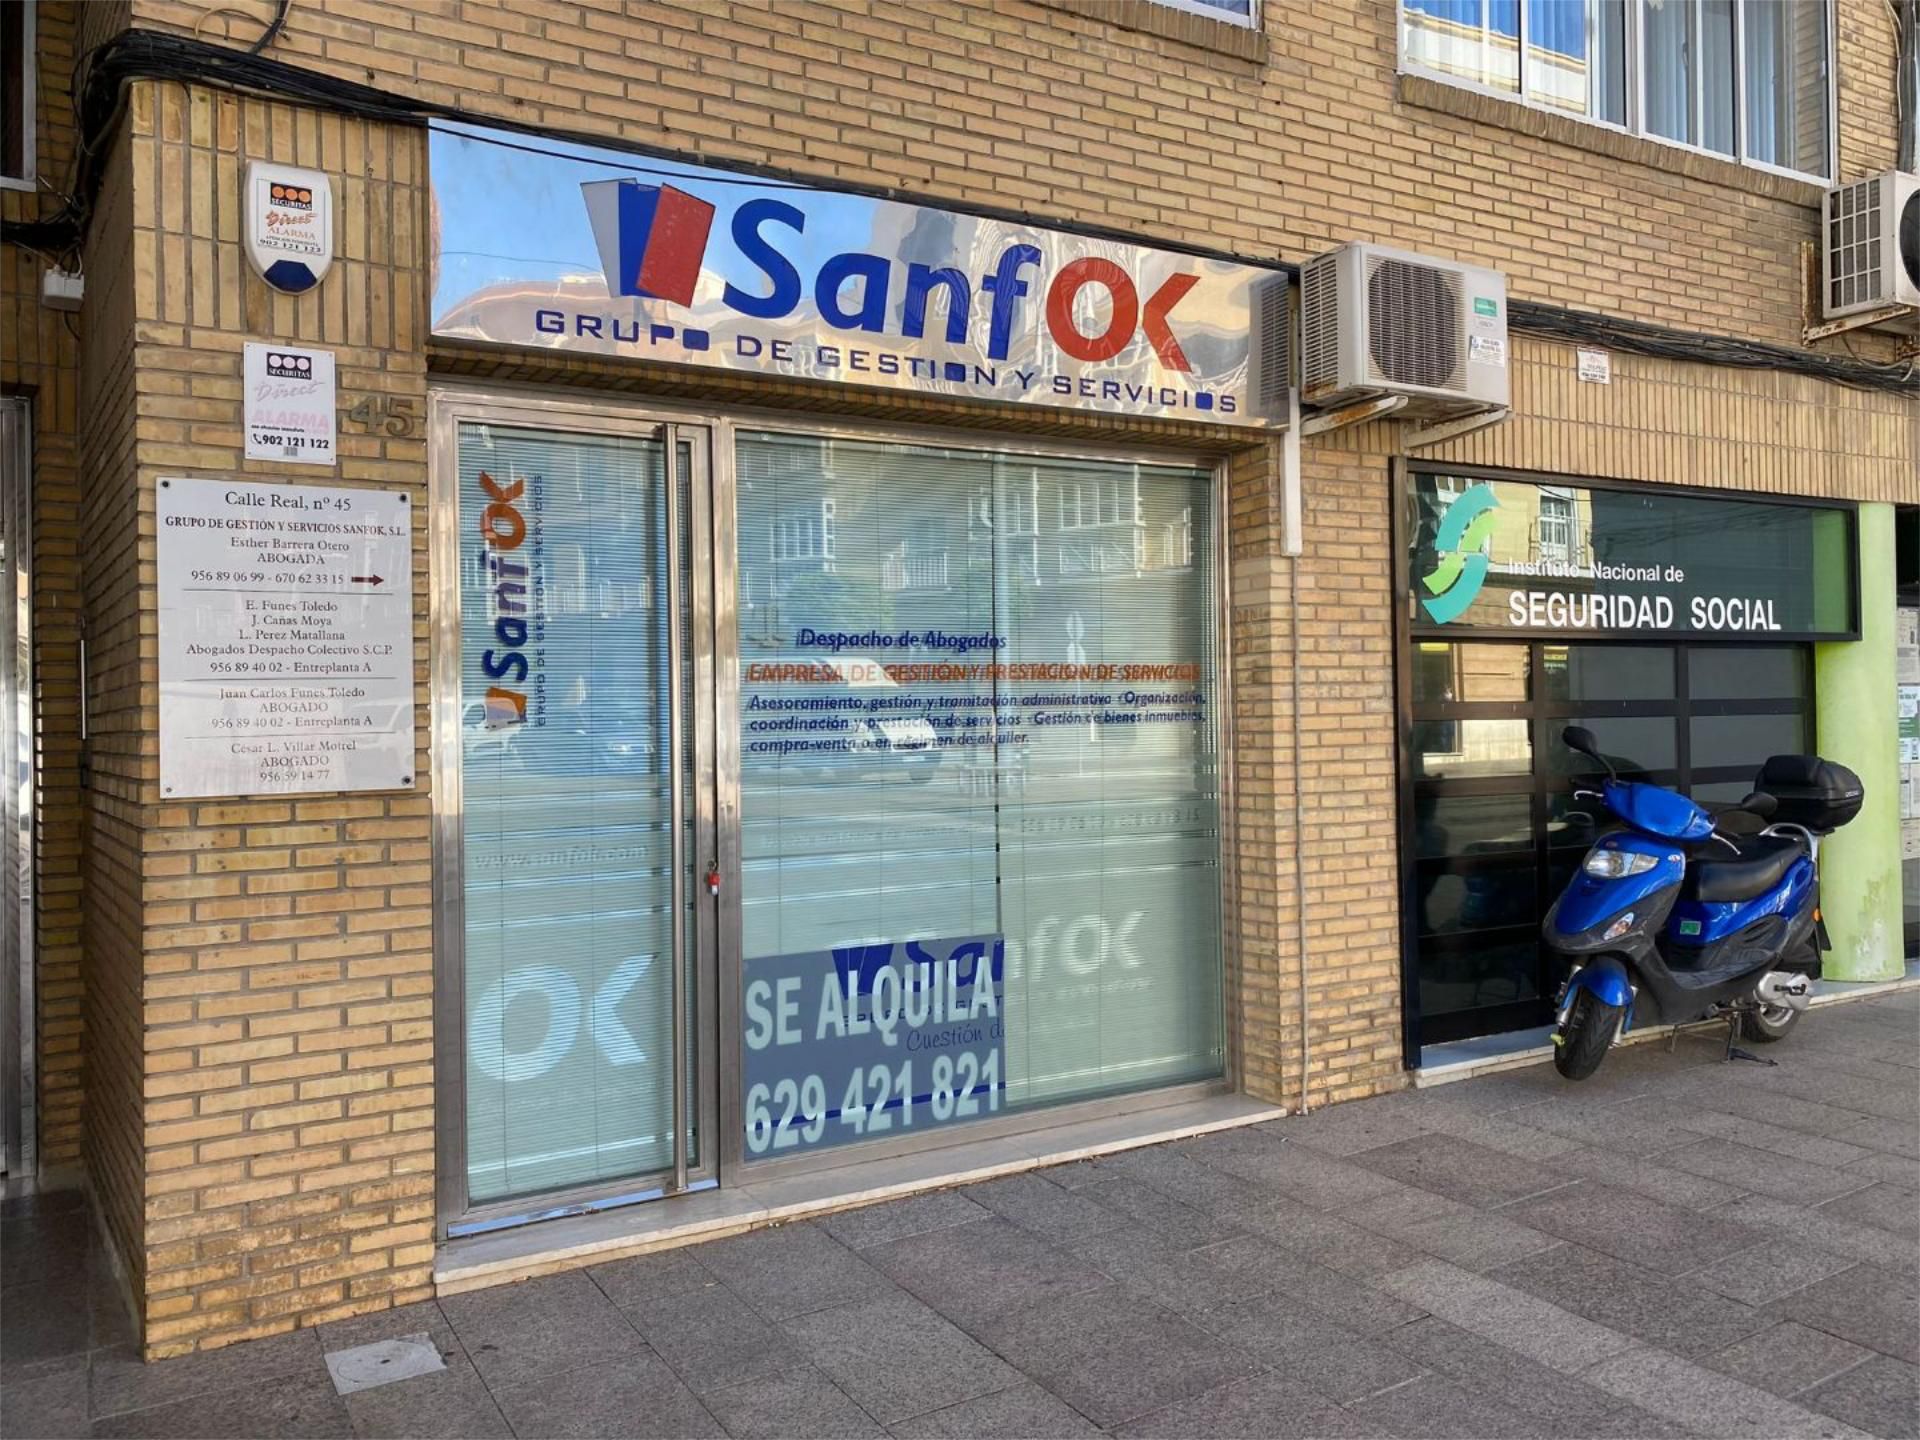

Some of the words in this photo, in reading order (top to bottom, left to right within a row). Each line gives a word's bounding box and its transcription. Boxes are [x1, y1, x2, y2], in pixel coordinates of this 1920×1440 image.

[267, 226, 316, 241] ALARMA
[722, 197, 1201, 373] SanfOK
[536, 309, 710, 351] GRUPO
[737, 335, 793, 361] DE
[817, 345, 996, 387] GESTION
[1016, 371, 1035, 390] Y
[1053, 375, 1237, 413] SERVICIOS
[268, 368, 310, 379] SECURITAS
[254, 380, 327, 402] Direct
[253, 409, 330, 435] ALARMA
[350, 393, 415, 438] 45
[262, 434, 283, 446] 902
[287, 436, 305, 448] 121
[310, 438, 330, 449] 122
[225, 490, 263, 507] Calle
[270, 493, 309, 511] Real,
[334, 498, 352, 512] 45
[165, 515, 206, 528] GRUPO
[208, 517, 224, 529] DE
[278, 520, 285, 532] Y
[287, 522, 341, 534] SERVICIOS
[389, 526, 406, 537] S.L.
[231, 536, 269, 550] Esther
[273, 537, 314, 550] Barrera
[318, 539, 350, 552] Otero
[257, 552, 325, 565] ABOGADA
[191, 570, 213, 582] 956
[216, 571, 231, 582] 89
[233, 571, 248, 583] 06
[250, 572, 265, 583] 99
[275, 573, 296, 584] 670
[298, 574, 312, 584] 62
[315, 574, 328, 585] 33
[331, 574, 344, 585] 15
[1508, 557, 1580, 579] Instituto
[1591, 561, 1660, 583] Nacional
[1664, 564, 1685, 584] de
[246, 600, 258, 611] E.
[262, 600, 297, 611] Funes
[300, 600, 338, 612] Toledo
[1508, 589, 1674, 630] SEGURIDAD
[1690, 596, 1782, 632] SOCIAL
[251, 614, 260, 627] J.
[263, 614, 298, 626] Cañas
[301, 615, 332, 629] Moya
[239, 629, 252, 640] L.
[290, 629, 345, 641] Matallana
[799, 628, 894, 650] Despacho
[900, 630, 919, 646] de
[924, 630, 1007, 652] Abogados
[187, 643, 245, 656] Abogados
[249, 644, 305, 656] Despacho
[307, 644, 360, 655] Colectivo
[362, 644, 393, 656] S.C.P.
[535, 649, 545, 667] DE
[210, 662, 232, 673] 956
[235, 662, 249, 673] 89
[252, 662, 266, 673] 40
[268, 662, 283, 673] 02
[293, 662, 360, 675] Entreplanta
[363, 662, 372, 673] A
[747, 663, 843, 682] EMPRESA
[851, 663, 877, 682] DE
[971, 664, 981, 681] Y
[1097, 663, 1119, 680] DE
[1122, 663, 1200, 680] SERVICIOS
[219, 688, 247, 700] Juan
[250, 687, 287, 699] Carlos
[291, 687, 325, 698] Funes
[328, 687, 365, 698] Toledo
[259, 701, 329, 713] ABOGADO
[749, 694, 868, 711] Asesoramiento,
[871, 694, 921, 713] gestión
[926, 698, 936, 712] y
[940, 693, 1017, 709] tramitación
[1022, 692, 1112, 707] administrativa
[211, 718, 233, 729] 956
[236, 718, 250, 729] 89
[253, 717, 267, 728] 40
[269, 717, 284, 728] 02
[295, 715, 360, 728] Entreplanta
[363, 715, 373, 726] A
[750, 714, 849, 731] coordinación
[945, 713, 960, 727] de
[1033, 710, 1081, 726] Gestión
[1103, 709, 1140, 725] bienes
[267, 742, 279, 753] L.
[283, 741, 315, 753] Villar
[957, 732, 973, 746] de
[260, 755, 330, 768] ABOGADO
[259, 772, 281, 783] 956
[301, 770, 314, 781] 14
[317, 770, 330, 780] 77
[744, 976, 803, 1051] SE
[816, 956, 997, 1047] ALQUILA
[469, 951, 661, 1083] OK
[906, 1022, 982, 1051] Cuestión
[745, 1074, 827, 1153] 629
[840, 1059, 913, 1135] 421
[931, 1048, 999, 1122] 821
